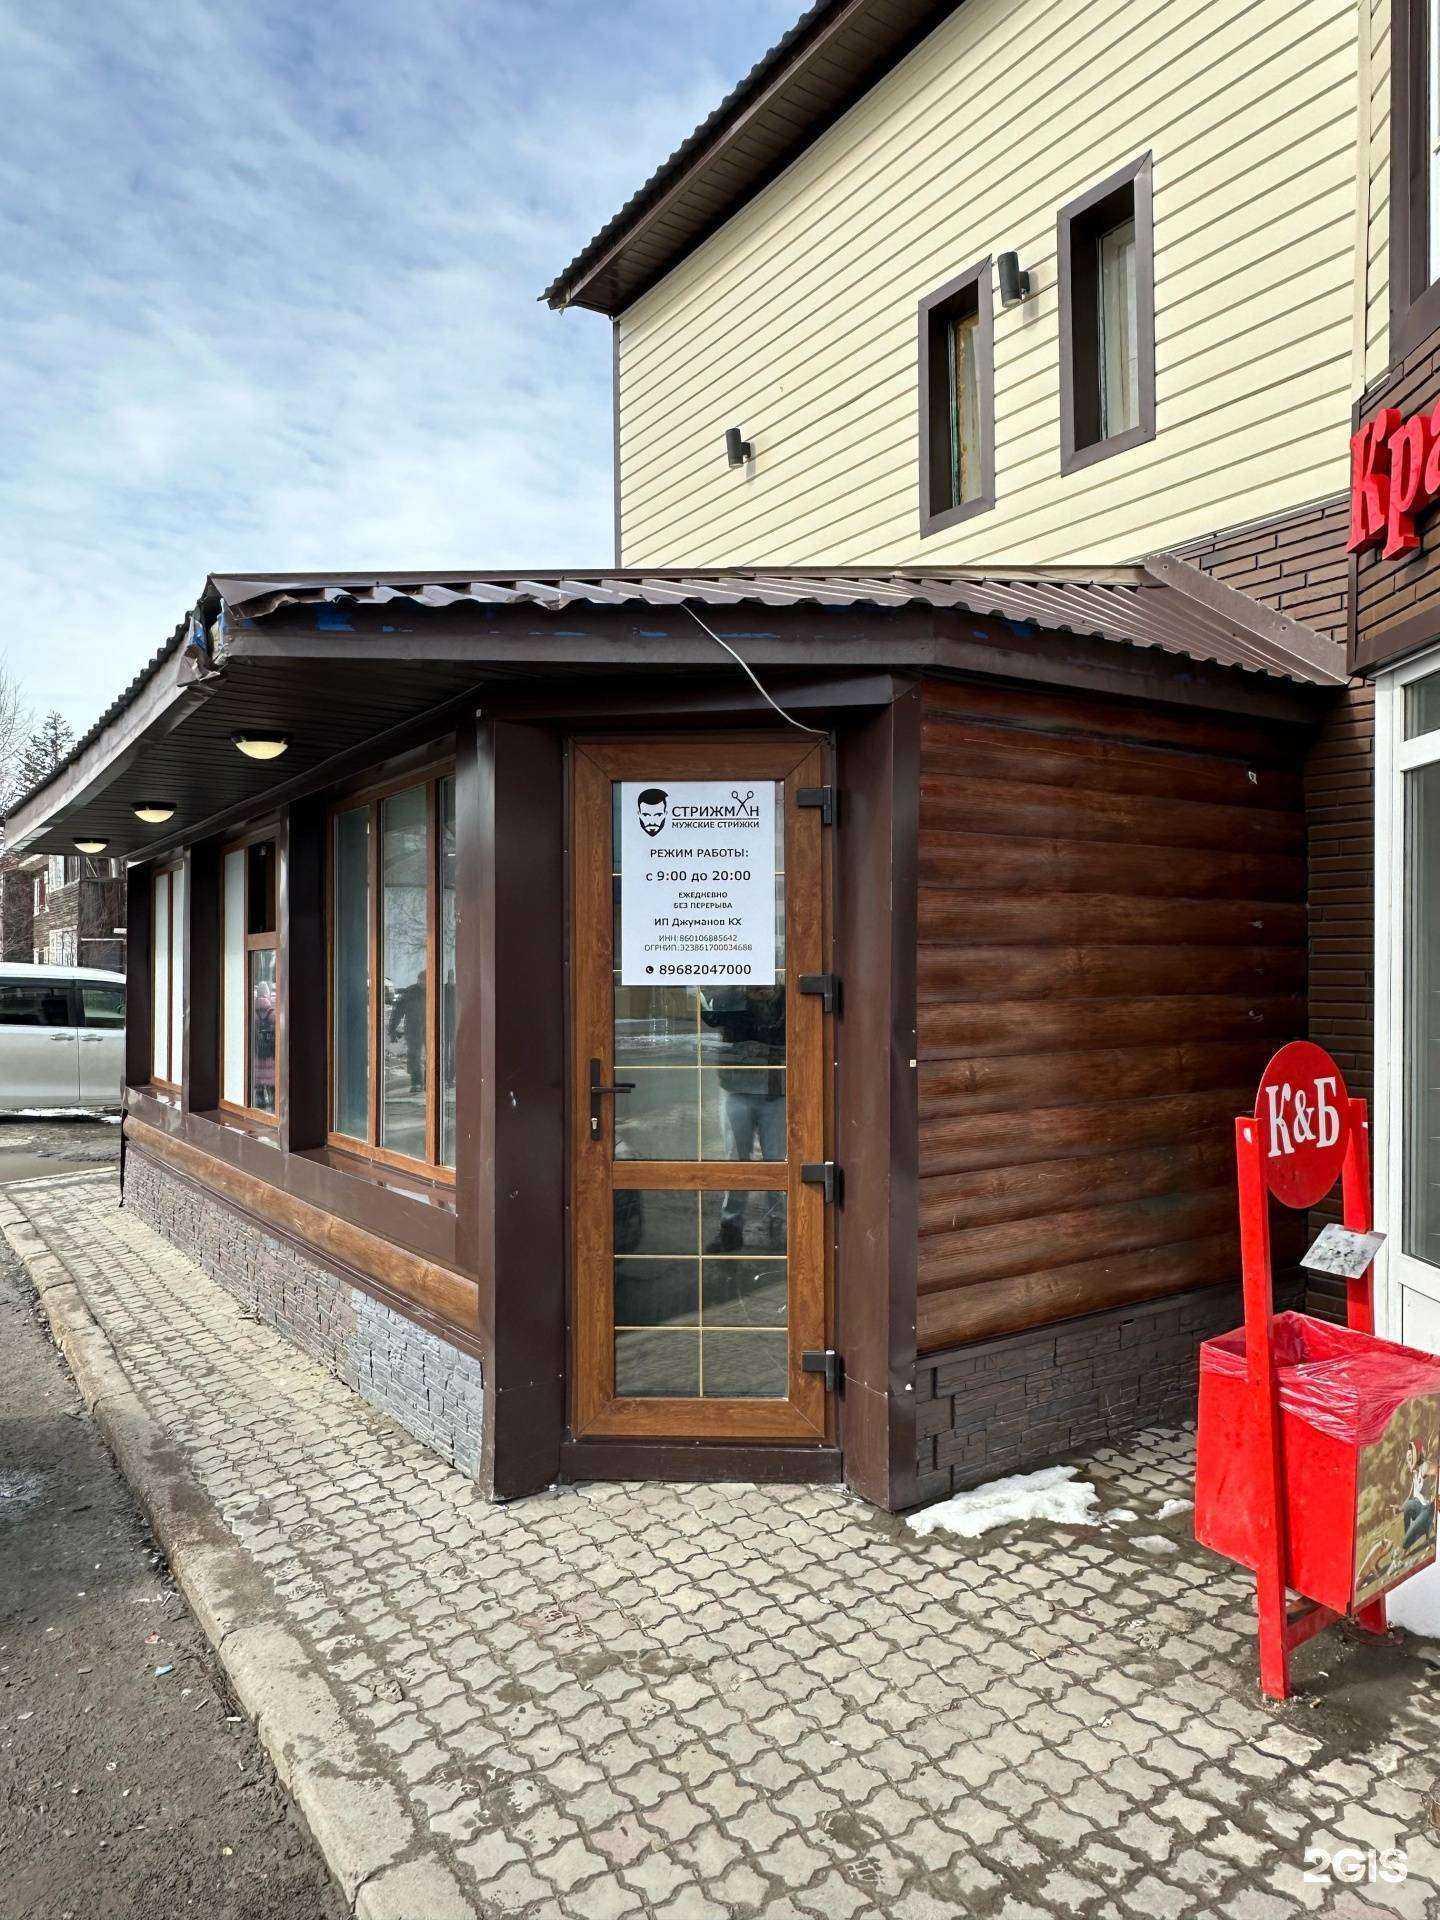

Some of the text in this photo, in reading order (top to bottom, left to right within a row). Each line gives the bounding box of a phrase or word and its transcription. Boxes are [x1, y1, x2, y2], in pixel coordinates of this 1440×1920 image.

[672, 821, 760, 829] МУЖСКИЕ СТРИЖКИ
[650, 848, 749, 858] РЕЖИМ РАБОТЫ:
[656, 870, 687, 881] 9:00
[691, 873, 708, 884] до
[712, 870, 751, 881] 20:00
[678, 891, 728, 899] ЕЖЕДНЕВНО
[654, 918, 669, 926] ИП
[728, 917, 742, 926] КХ
[659, 964, 751, 975] 89682047000
